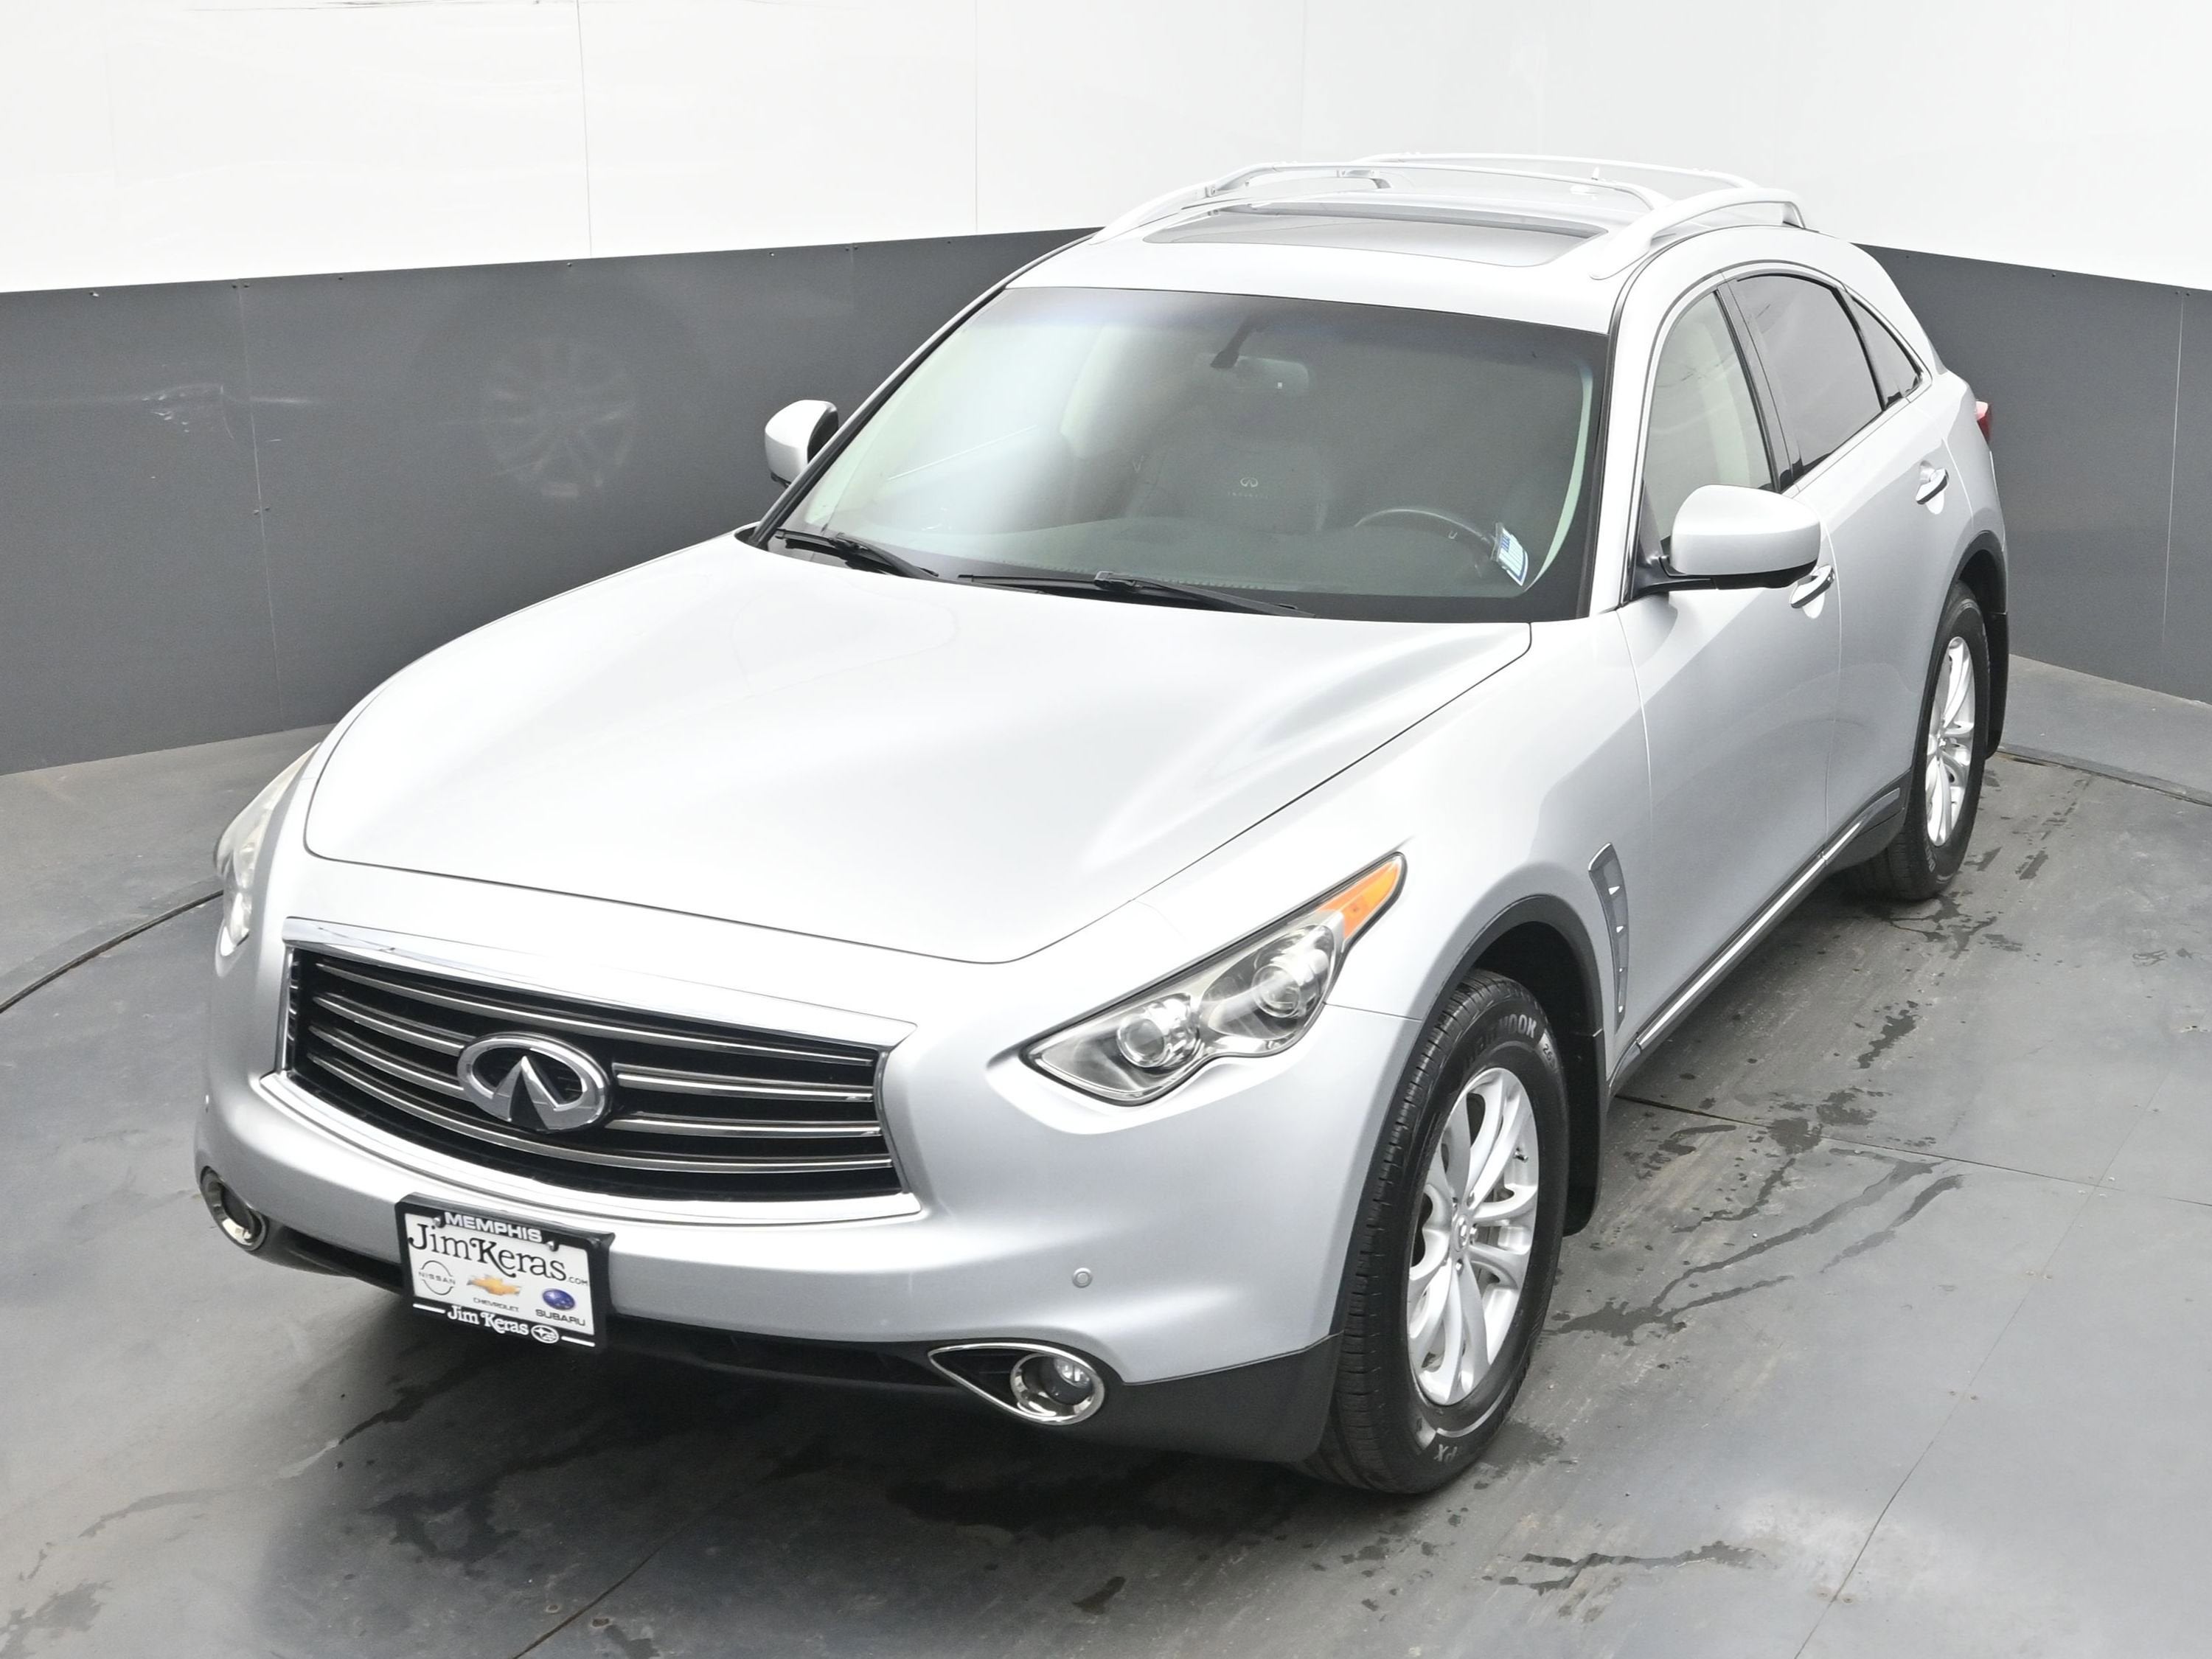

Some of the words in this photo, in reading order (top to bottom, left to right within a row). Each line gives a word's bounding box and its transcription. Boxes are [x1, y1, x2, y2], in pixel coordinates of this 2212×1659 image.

[444, 1212, 543, 1242] MEMPHIS
[418, 1270, 456, 1285] NISSAN
[473, 1297, 519, 1312] CHEVROLET
[447, 1305, 480, 1325] Jim
[480, 1312, 529, 1335] Keras
[535, 1309, 586, 1326] SUBARU
